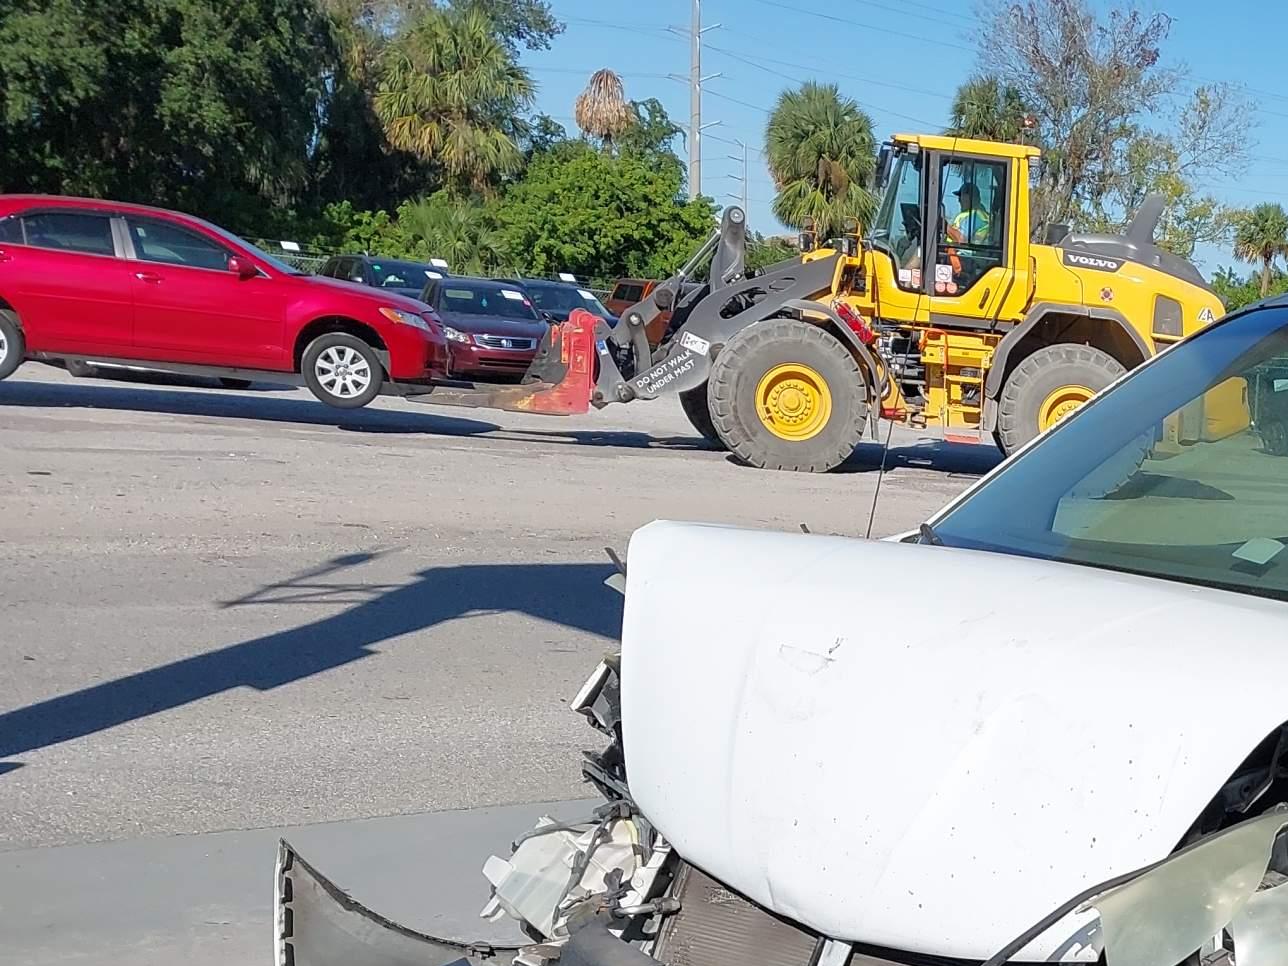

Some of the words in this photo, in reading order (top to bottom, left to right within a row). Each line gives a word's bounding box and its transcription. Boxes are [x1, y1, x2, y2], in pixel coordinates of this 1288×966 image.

[1067, 254, 1118, 269] VOLVO
[636, 376, 650, 388] DO
[650, 363, 669, 380] NOT
[667, 350, 692, 369] WALK
[646, 373, 674, 394] UNDER
[673, 359, 695, 378] MAST
